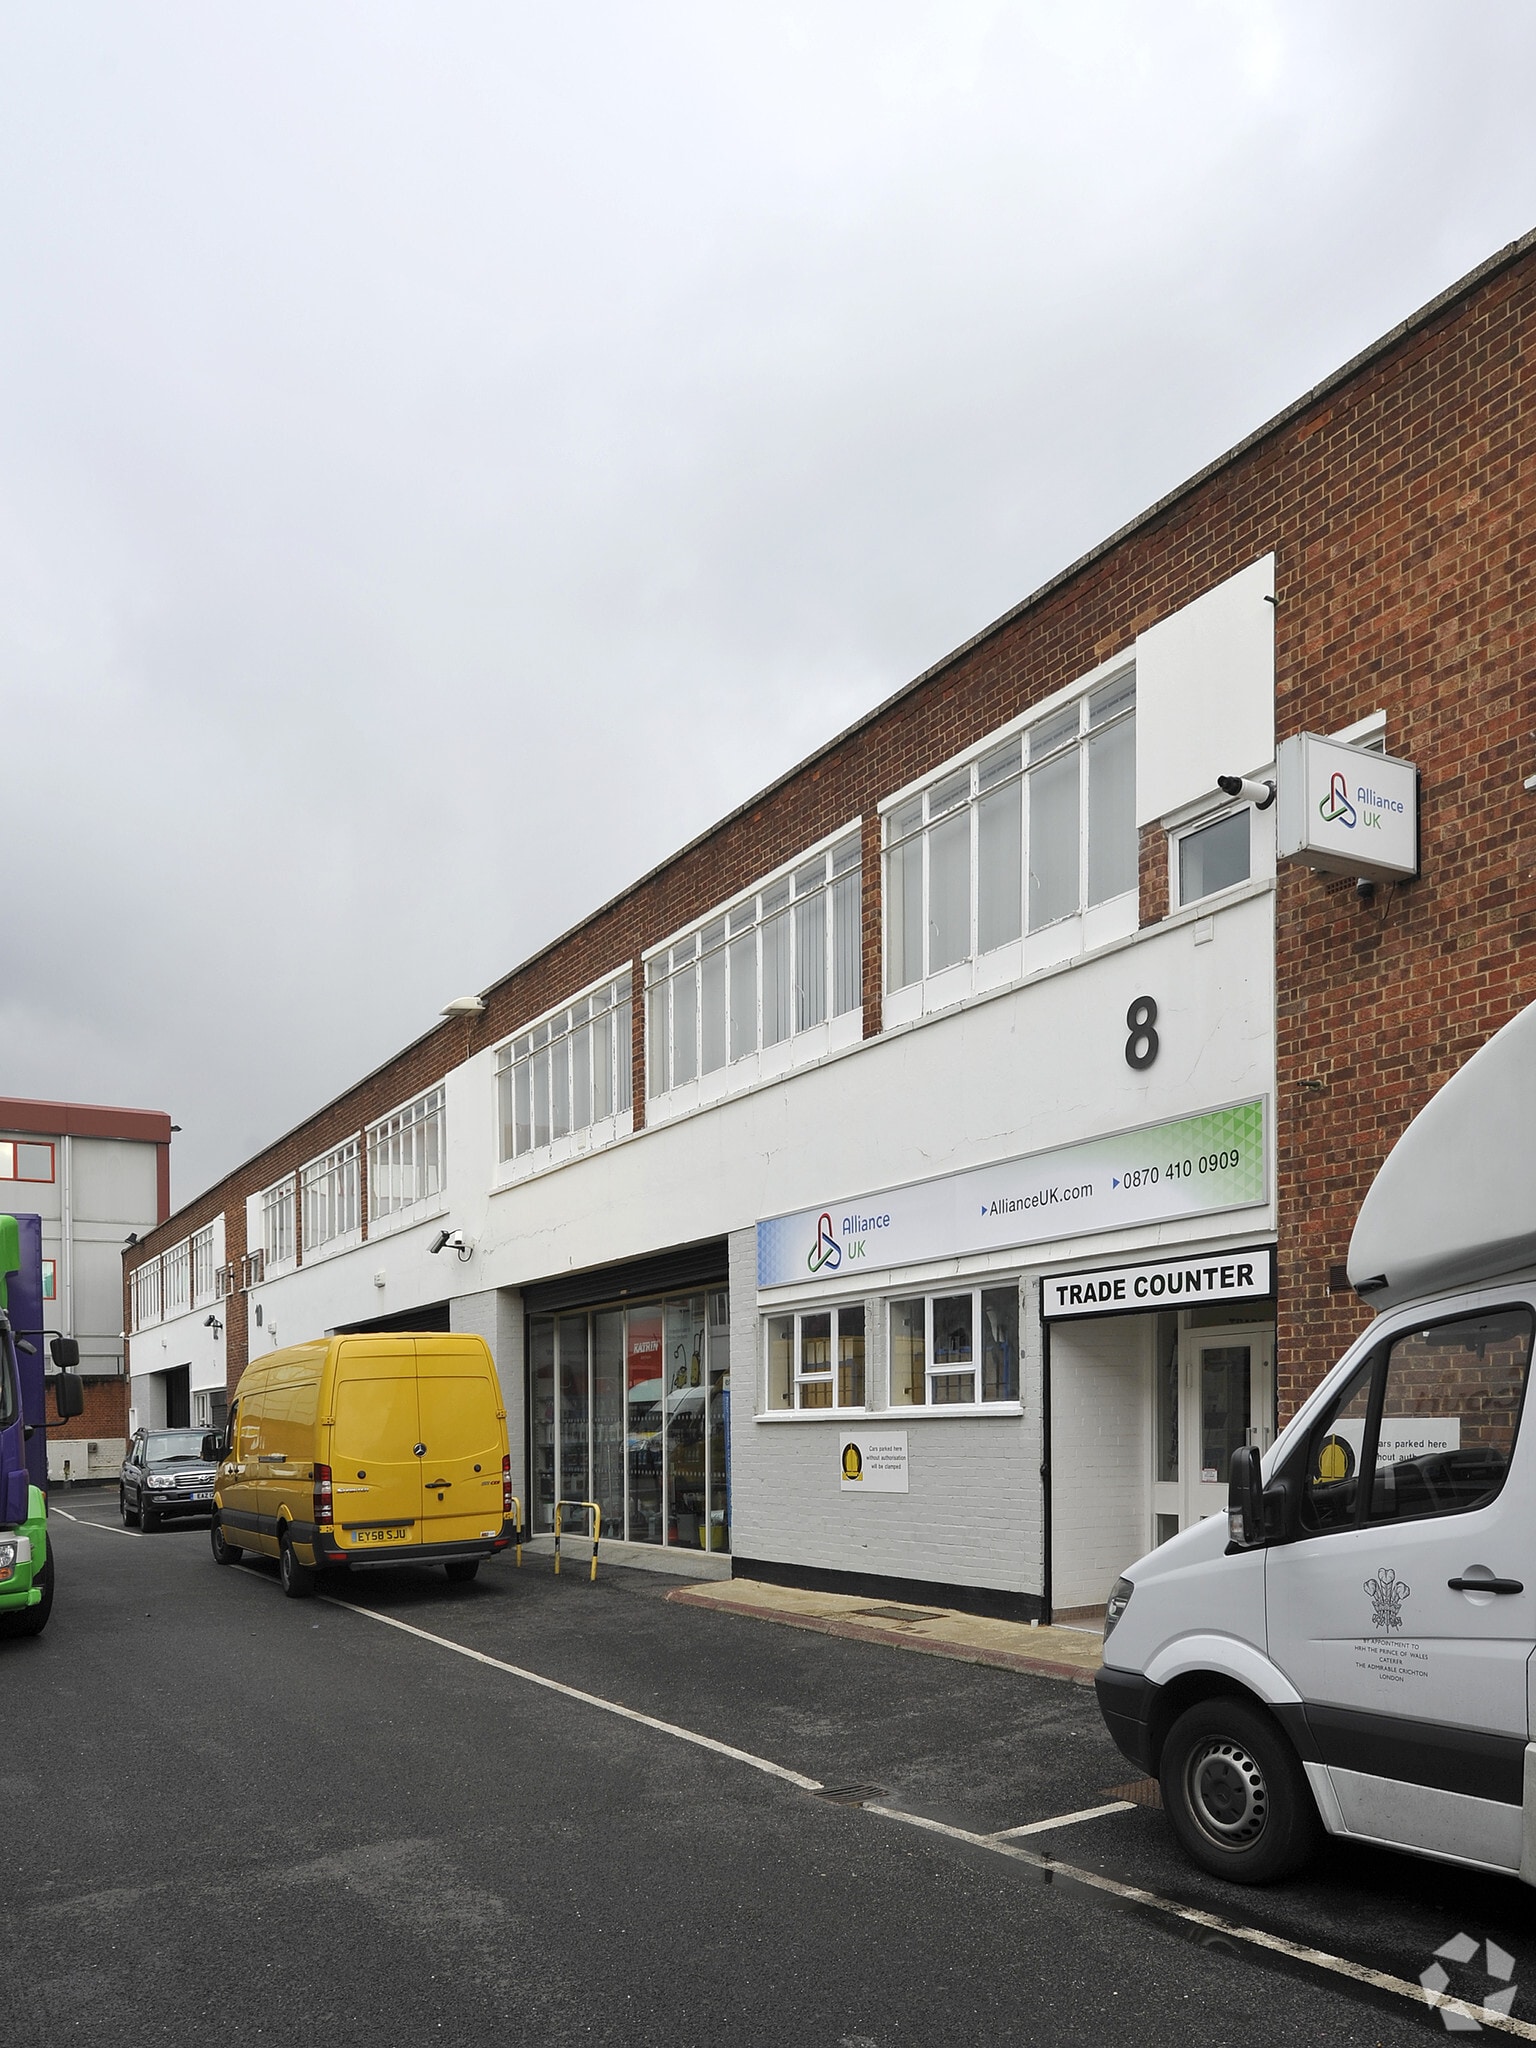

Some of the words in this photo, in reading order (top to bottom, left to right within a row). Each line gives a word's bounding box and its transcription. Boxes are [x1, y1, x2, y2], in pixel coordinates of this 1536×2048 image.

[1357, 787, 1404, 813] Alliance
[1364, 810, 1381, 830] UK
[1125, 995, 1159, 1070] 8
[989, 1183, 1093, 1217] AllianceUK.com
[1123, 1166, 1159, 1189] 0870
[1165, 1159, 1192, 1181] 410
[1198, 1149, 1239, 1174] 0909
[842, 1214, 890, 1235] Alliance
[848, 1240, 866, 1259] UK
[1056, 1278, 1126, 1306] TRADE
[1134, 1263, 1254, 1298] COUNTER
[633, 1340, 659, 1354] KATRIN
[1378, 1440, 1392, 1448] ars
[1395, 1439, 1425, 1449] parked
[1427, 1439, 1448, 1448] here
[358, 1530, 384, 1541] EY58
[386, 1529, 406, 1539] SJU
[1371, 1639, 1409, 1648] APPOINTMENT
[1379, 1648, 1398, 1656] PRINCE
[1410, 1652, 1428, 1660] WALES
[1380, 1674, 1404, 1682] LONDON
